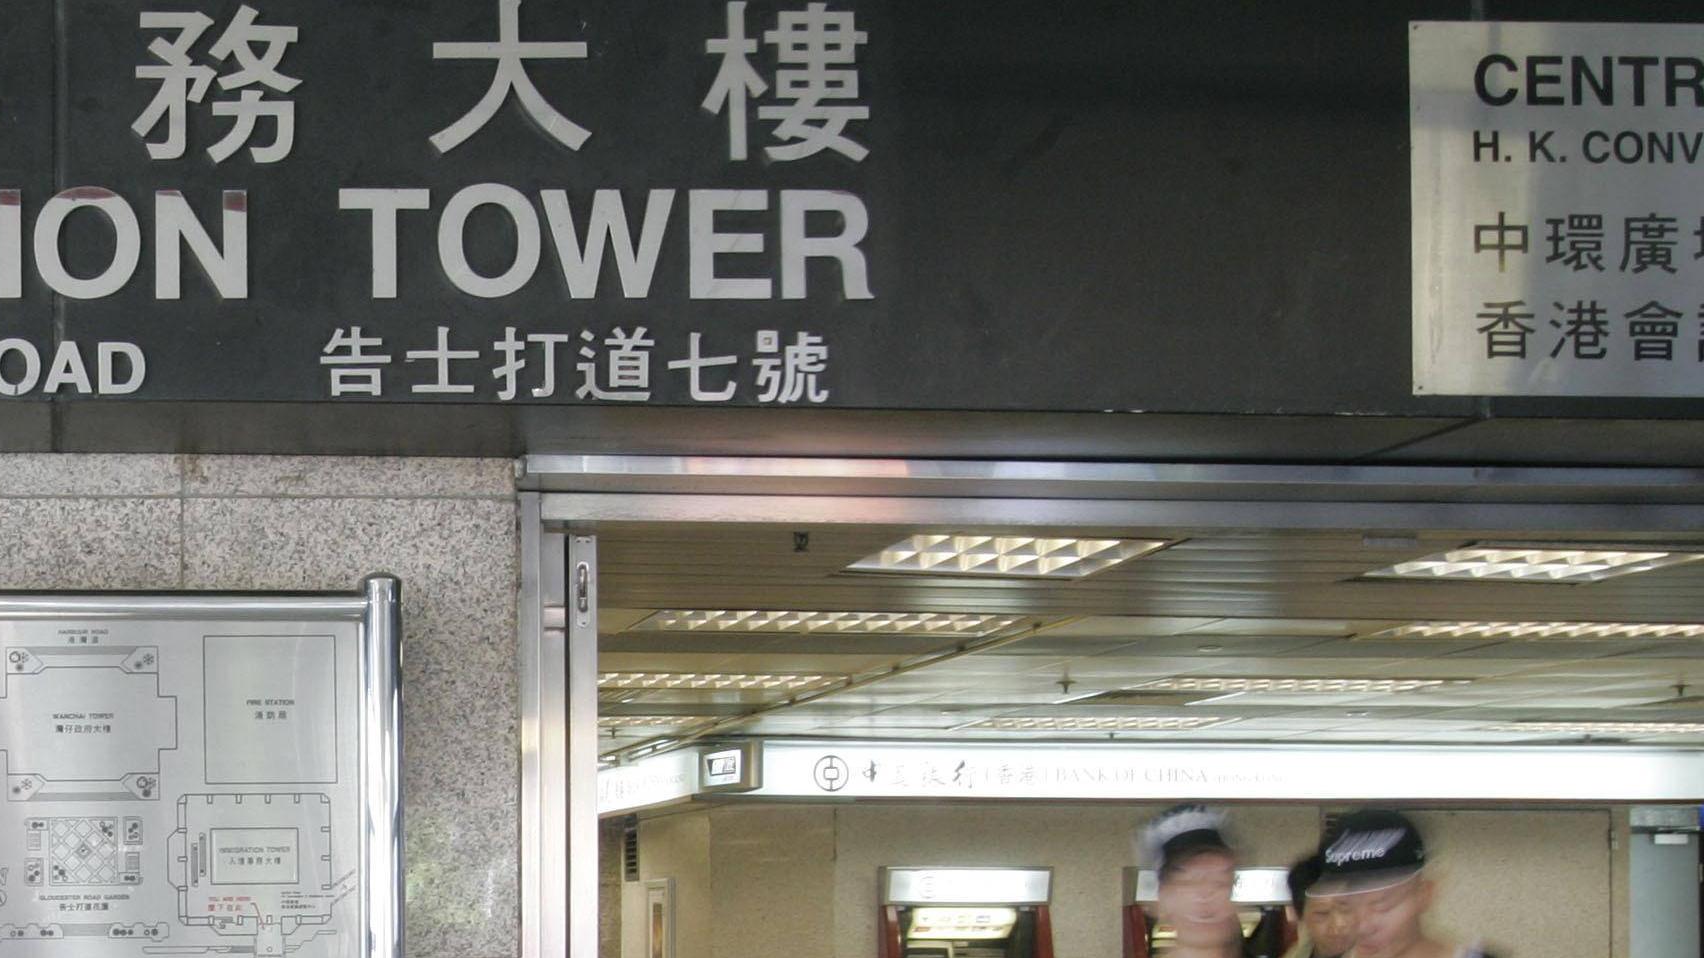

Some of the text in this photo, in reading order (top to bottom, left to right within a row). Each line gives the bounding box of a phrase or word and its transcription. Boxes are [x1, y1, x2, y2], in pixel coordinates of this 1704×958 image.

[1474, 54, 1704, 107] CENTR
[1582, 131, 1704, 163] CONV
[339, 183, 874, 300] TOWER
[1474, 211, 1704, 274] 中環廣
[1476, 300, 1704, 362] 香港會
[320, 326, 829, 404] 告士打道七號
[1144, 767, 1208, 784] CHINA
[1324, 847, 1385, 867] Supreme
